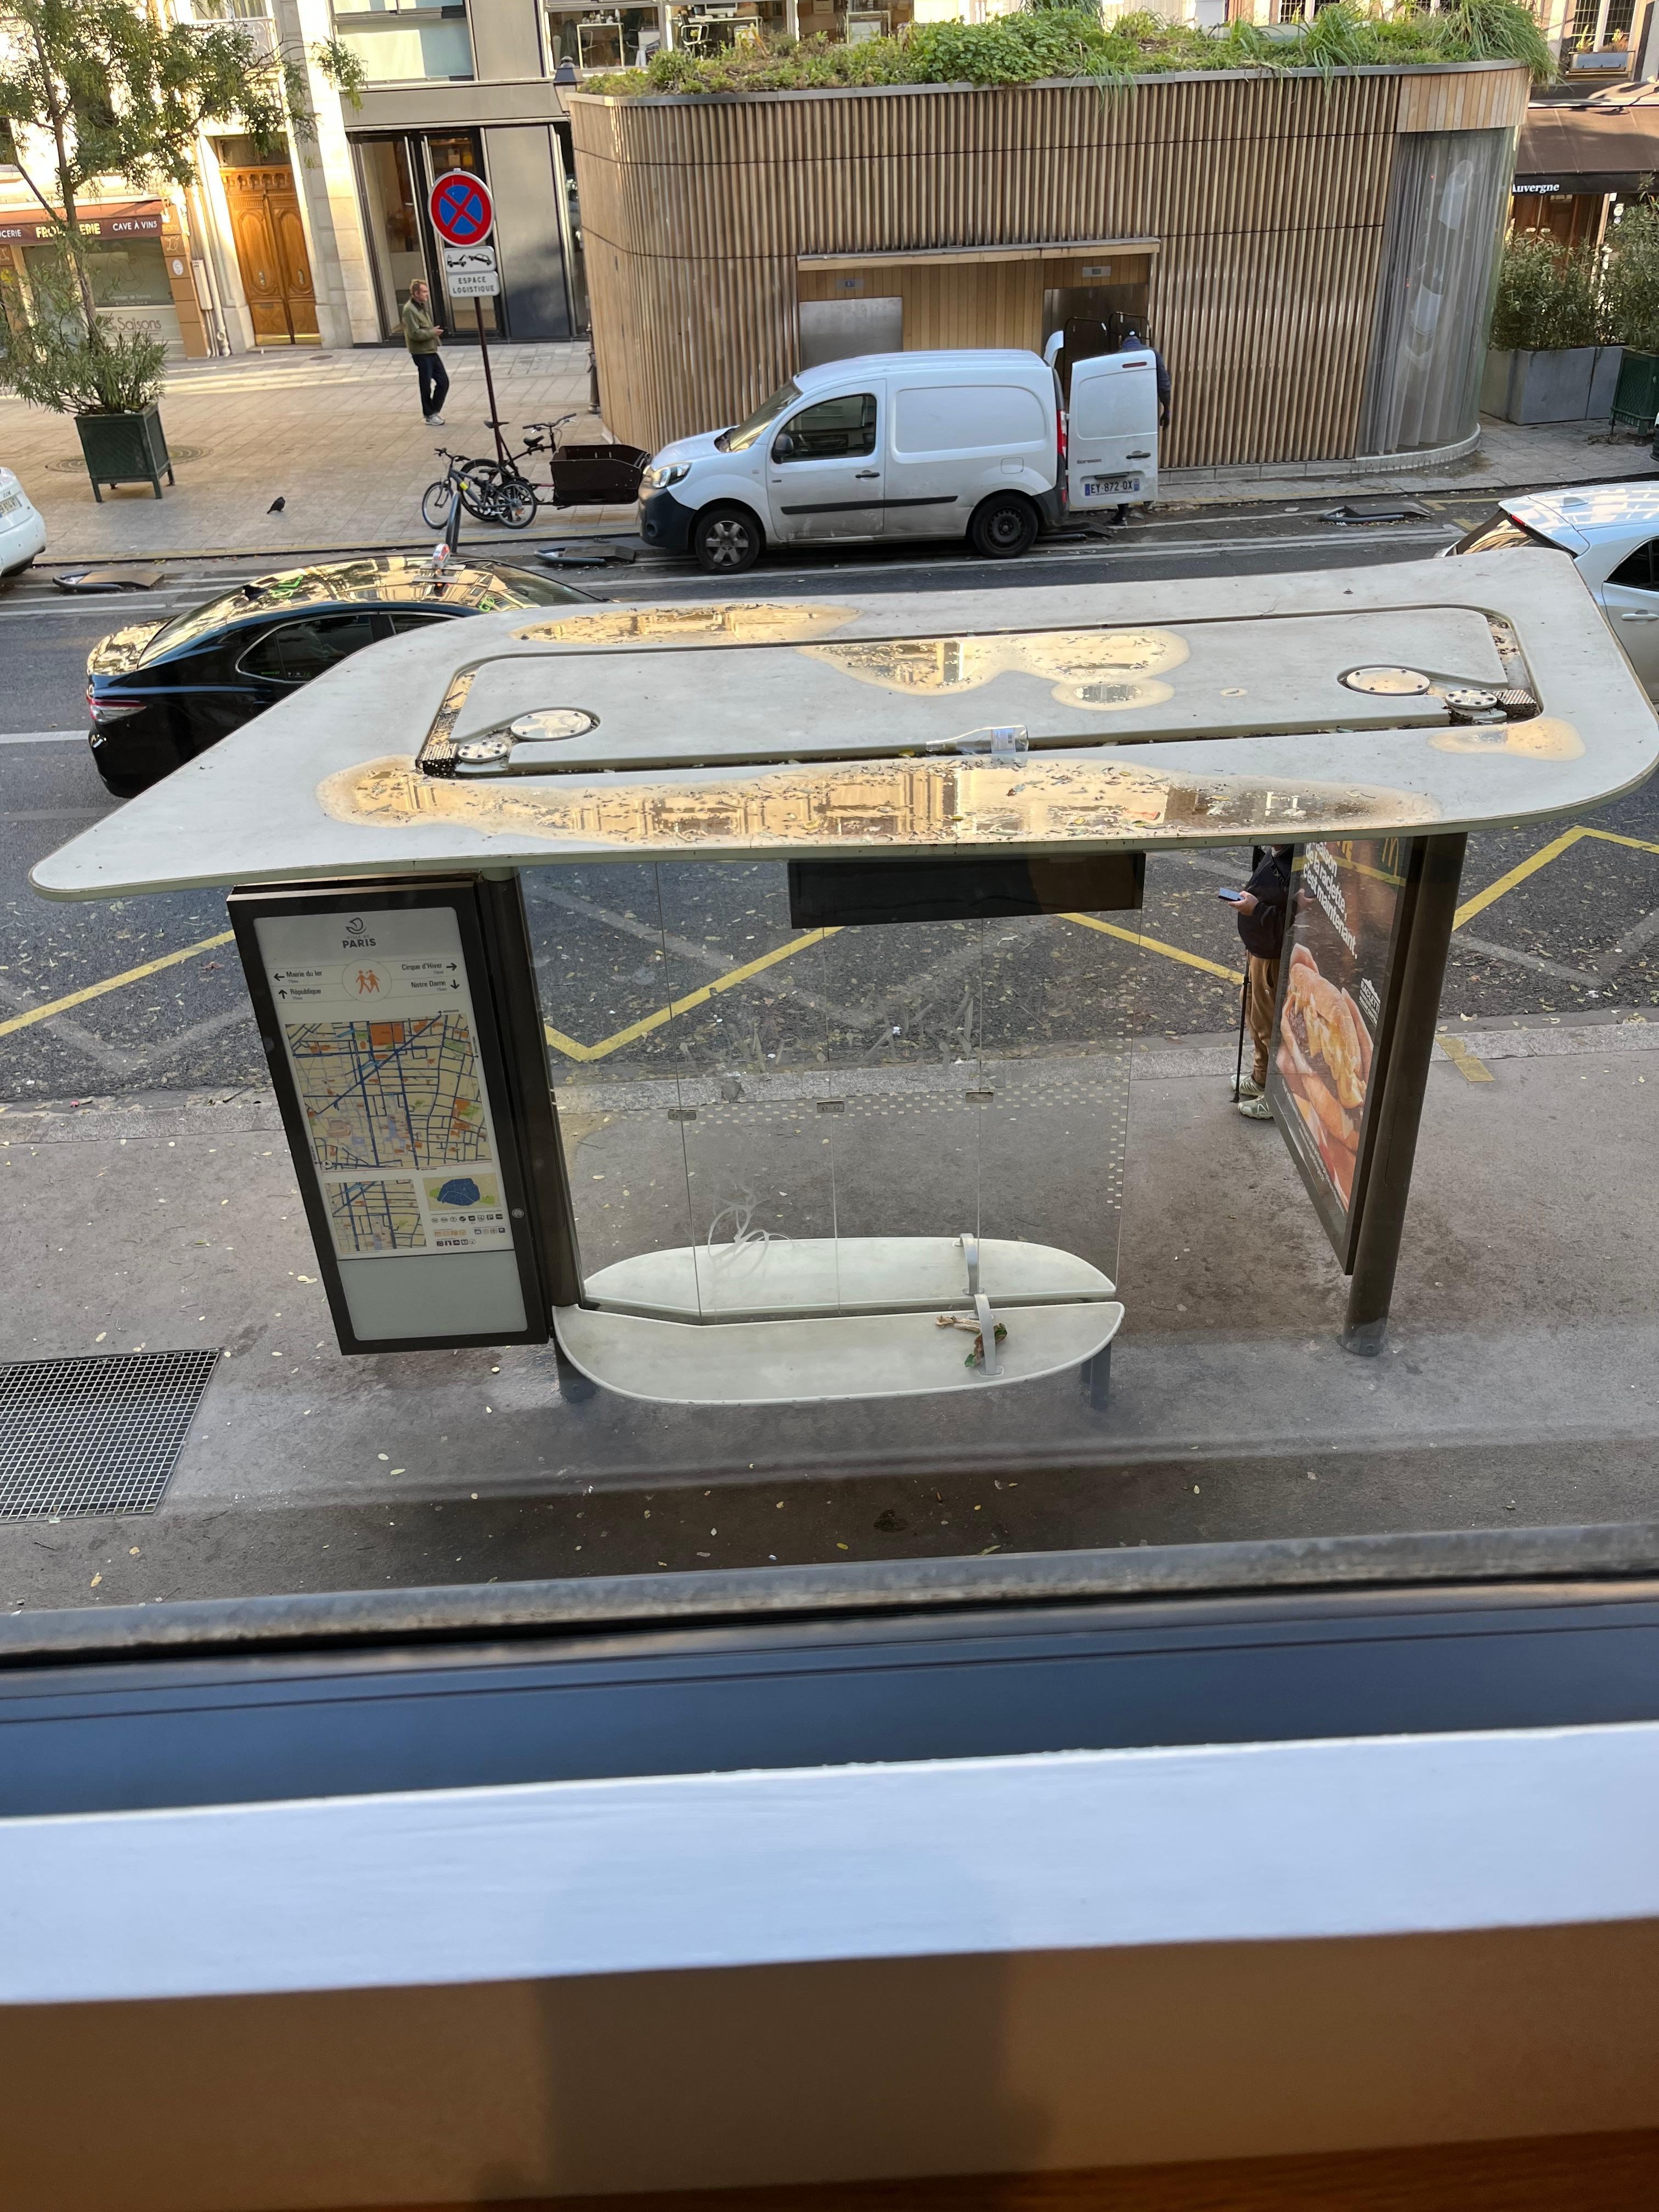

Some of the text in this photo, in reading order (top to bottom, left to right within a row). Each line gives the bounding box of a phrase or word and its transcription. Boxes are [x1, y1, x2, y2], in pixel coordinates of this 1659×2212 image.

[1513, 184, 1560, 194] Auvergne
[112, 222, 132, 231] CAVE
[134, 219, 139, 229] À
[141, 220, 157, 229] VINS
[458, 276, 487, 284] ESPACE
[452, 285, 495, 294] LOGISTIQUE
[117, 317, 162, 330] Saisons
[1313, 851, 1320, 876] la
[1317, 884, 1358, 960] maintenant.
[342, 938, 376, 949] PARIS
